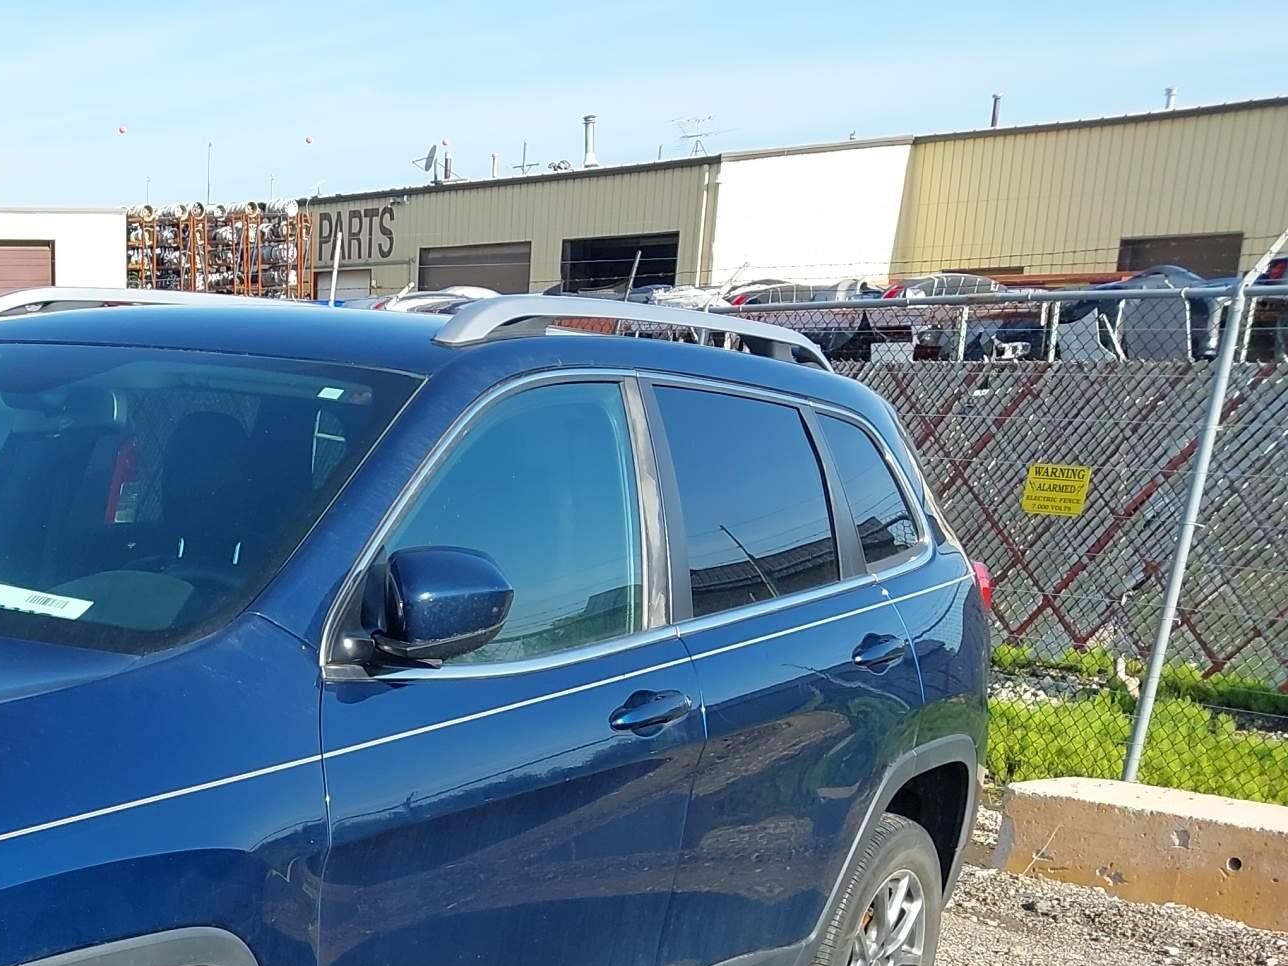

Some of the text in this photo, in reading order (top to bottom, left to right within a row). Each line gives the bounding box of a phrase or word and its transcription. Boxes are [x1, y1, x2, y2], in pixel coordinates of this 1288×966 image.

[318, 206, 395, 262] PARTS
[1034, 466, 1086, 480] WARNING
[1036, 483, 1076, 494] ALARMED
[1026, 495, 1081, 505] ELECTRIC FENCE
